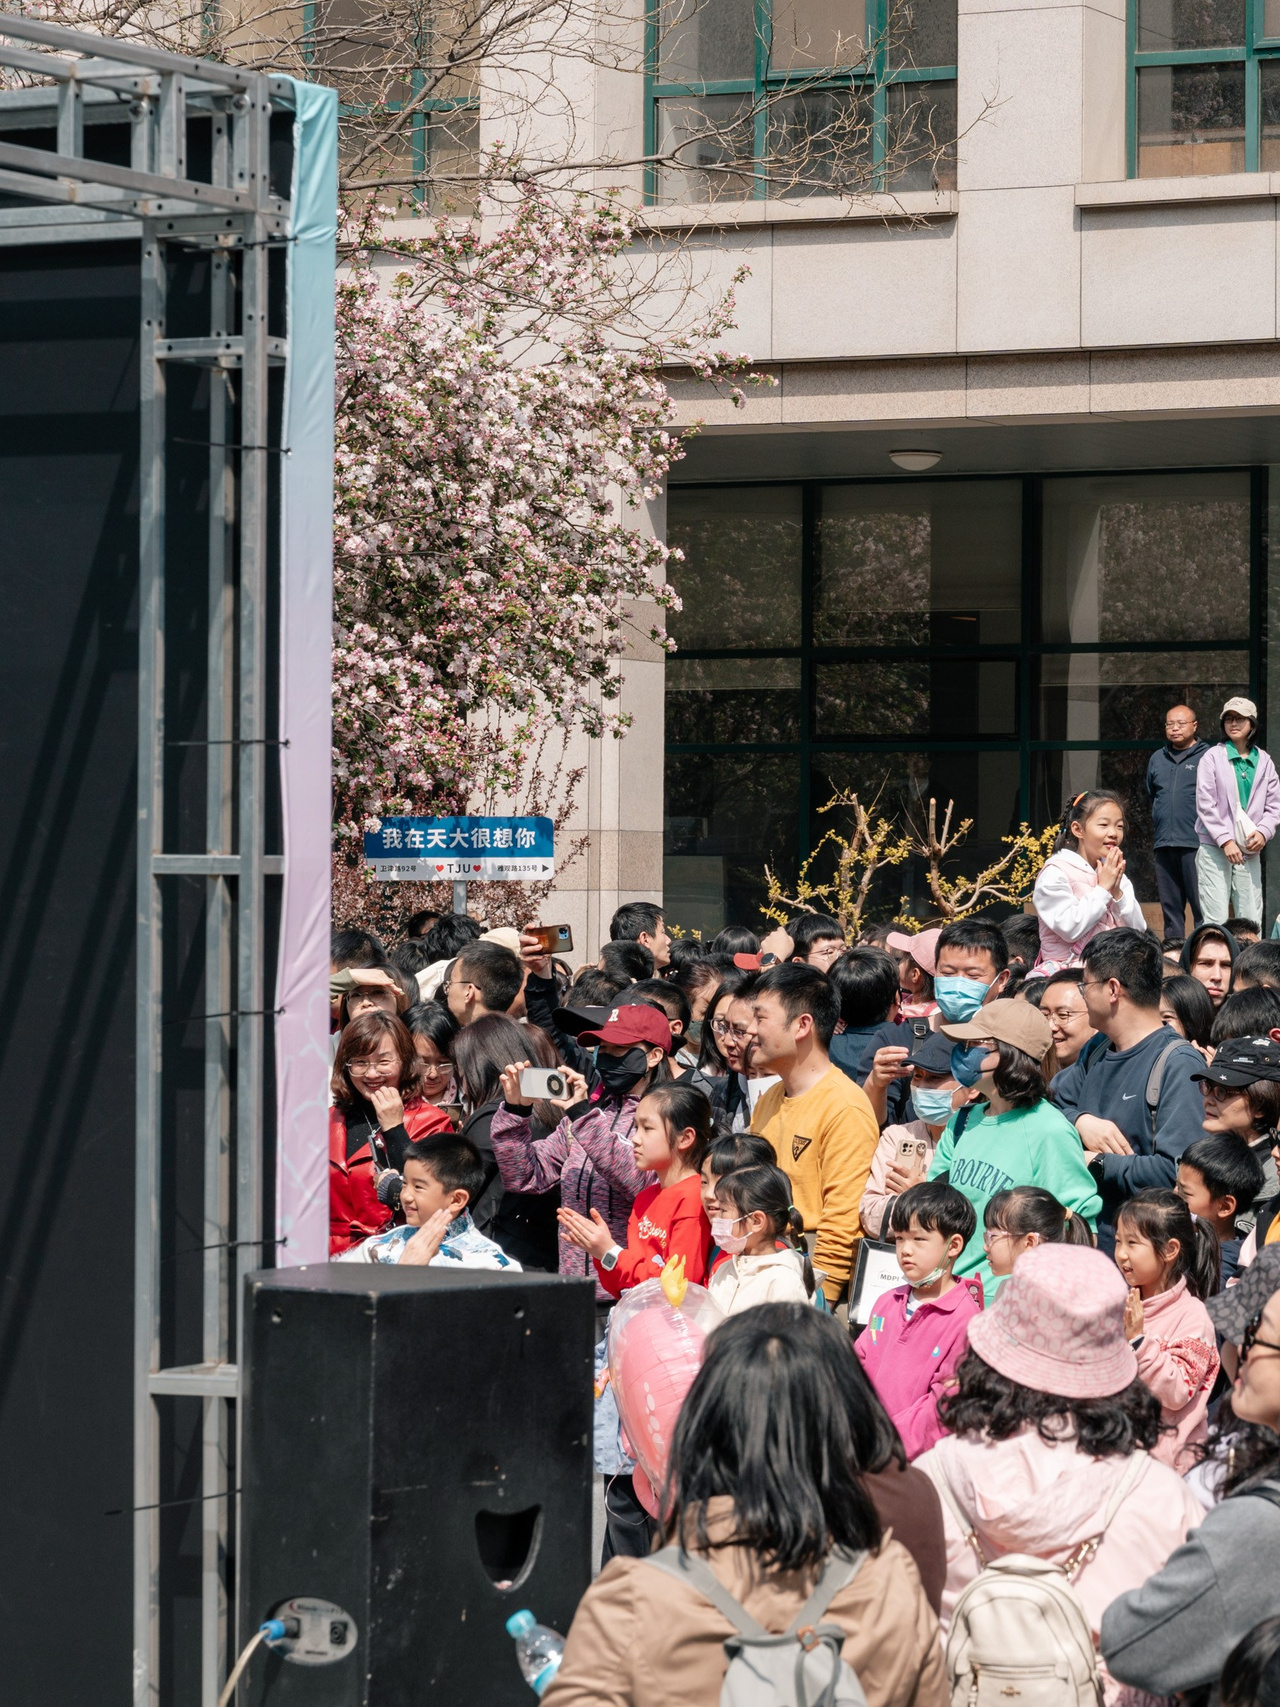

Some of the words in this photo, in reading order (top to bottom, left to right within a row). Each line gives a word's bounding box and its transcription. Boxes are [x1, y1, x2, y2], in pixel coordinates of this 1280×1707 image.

[382, 828, 536, 849] 我在天大很想你
[447, 863, 471, 874] TJU
[880, 1273, 900, 1282] MDPI
